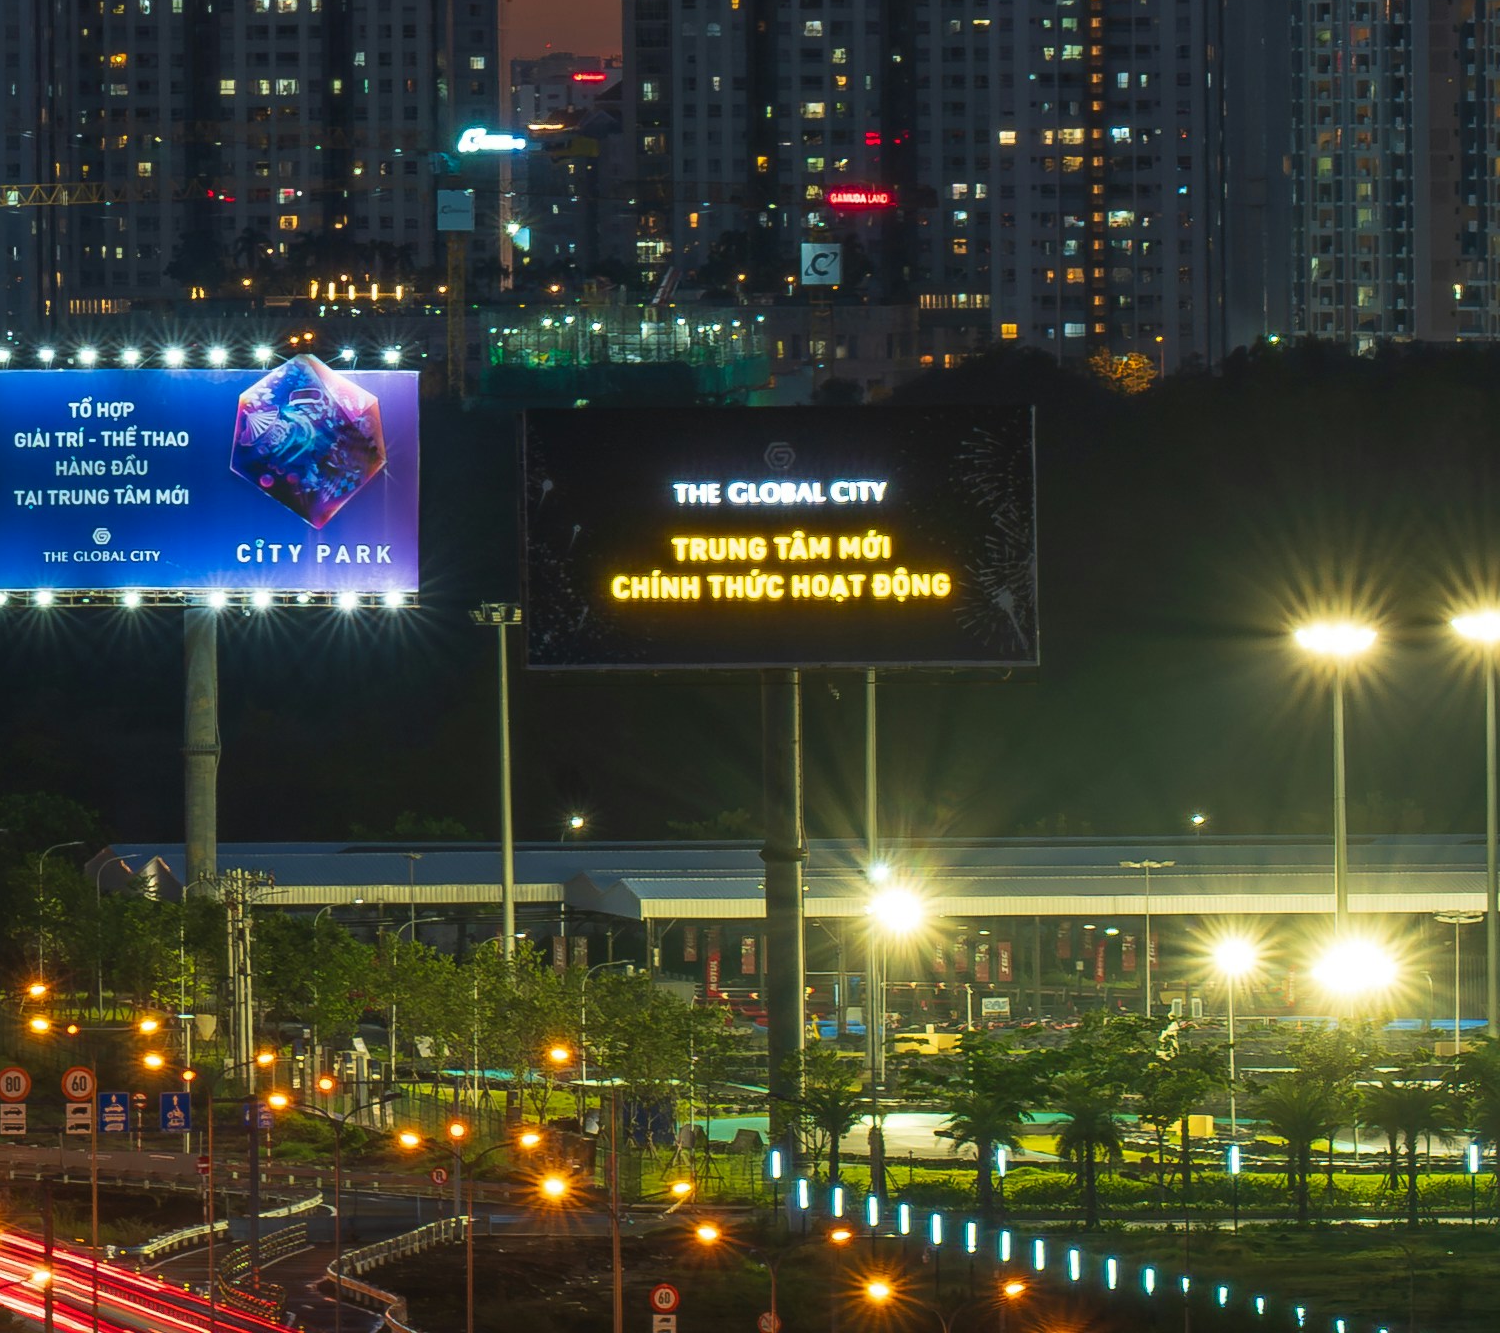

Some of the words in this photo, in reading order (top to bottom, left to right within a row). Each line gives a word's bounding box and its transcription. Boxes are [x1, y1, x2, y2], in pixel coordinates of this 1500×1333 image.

[68, 396, 92, 419] TỔ
[96, 400, 135, 422] HỢP
[14, 428, 50, 448] GIẢI
[55, 427, 84, 448] TRÍ
[100, 425, 137, 447] THỂ
[140, 431, 190, 447] THAO
[55, 455, 106, 476] HÀNG
[111, 454, 148, 476] ĐẦU
[13, 489, 43, 510] TẠI
[47, 489, 110, 505] TRUNG
[113, 484, 151, 505] TÂM
[155, 484, 190, 505] MỚI
[673, 482, 721, 505] THE
[727, 481, 826, 505] GLOBAL
[830, 480, 889, 504] CITY
[43, 551, 69, 563] THE
[73, 550, 126, 563] GLOBAL
[130, 549, 161, 562] CITY
[316, 543, 392, 564] PARK
[671, 536, 768, 562] TRUNG
[773, 530, 832, 561] TÂM
[838, 529, 893, 560] MỚI
[612, 569, 701, 600] CHÍNH
[706, 568, 785, 599] THỨC
[791, 573, 866, 603] HOẠT
[871, 566, 952, 603] ĐỘNG
[5, 1076, 20, 1092] 80
[71, 1075, 87, 1092] 60
[658, 1292, 671, 1305] 60
